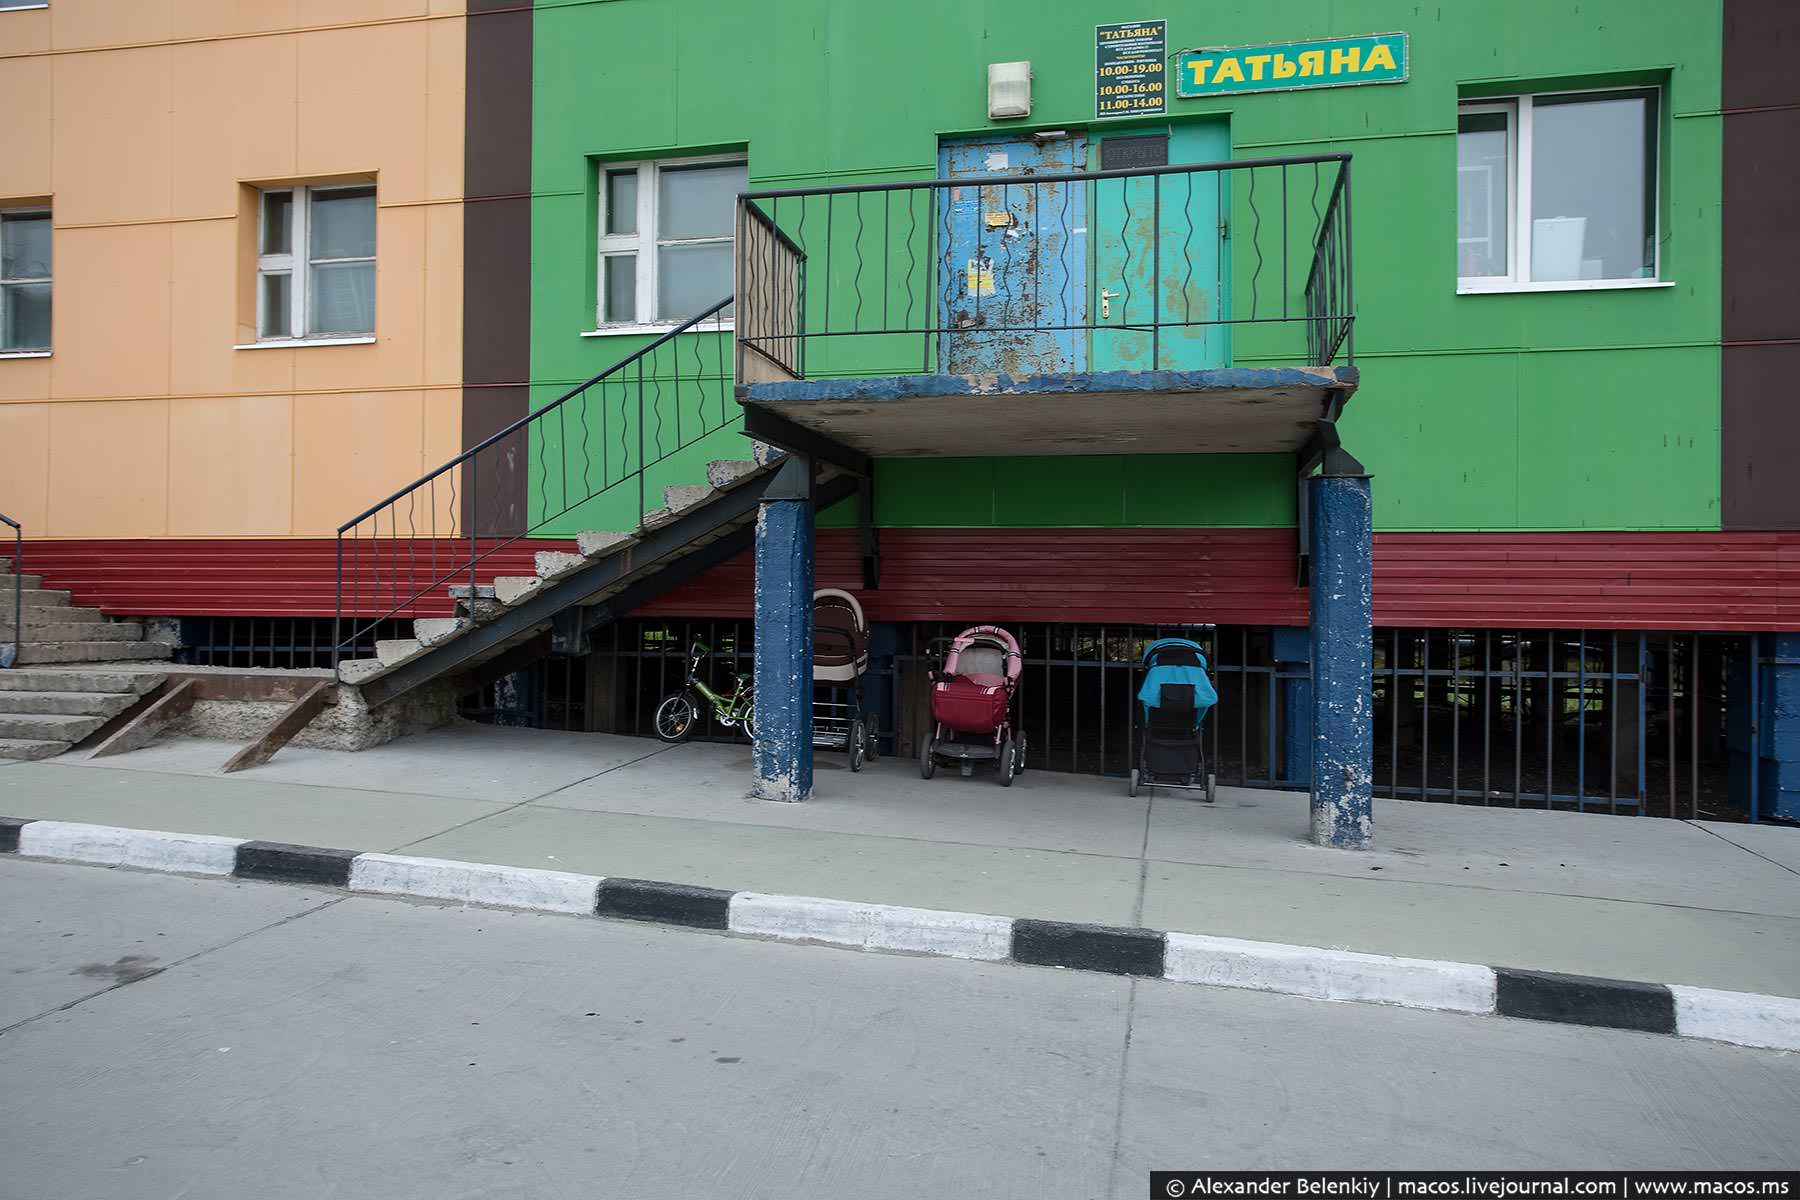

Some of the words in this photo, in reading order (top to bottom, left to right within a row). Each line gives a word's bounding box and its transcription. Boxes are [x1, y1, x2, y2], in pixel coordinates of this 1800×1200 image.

[1099, 26, 1163, 40] "ТАТЬЯНА"
[1099, 63, 1162, 76] 10.00-19.00
[1187, 44, 1397, 85] ТАТЬЯНА
[1099, 82, 1162, 96] 10.00-16.00
[1099, 97, 1162, 110] 11.00-14.00
